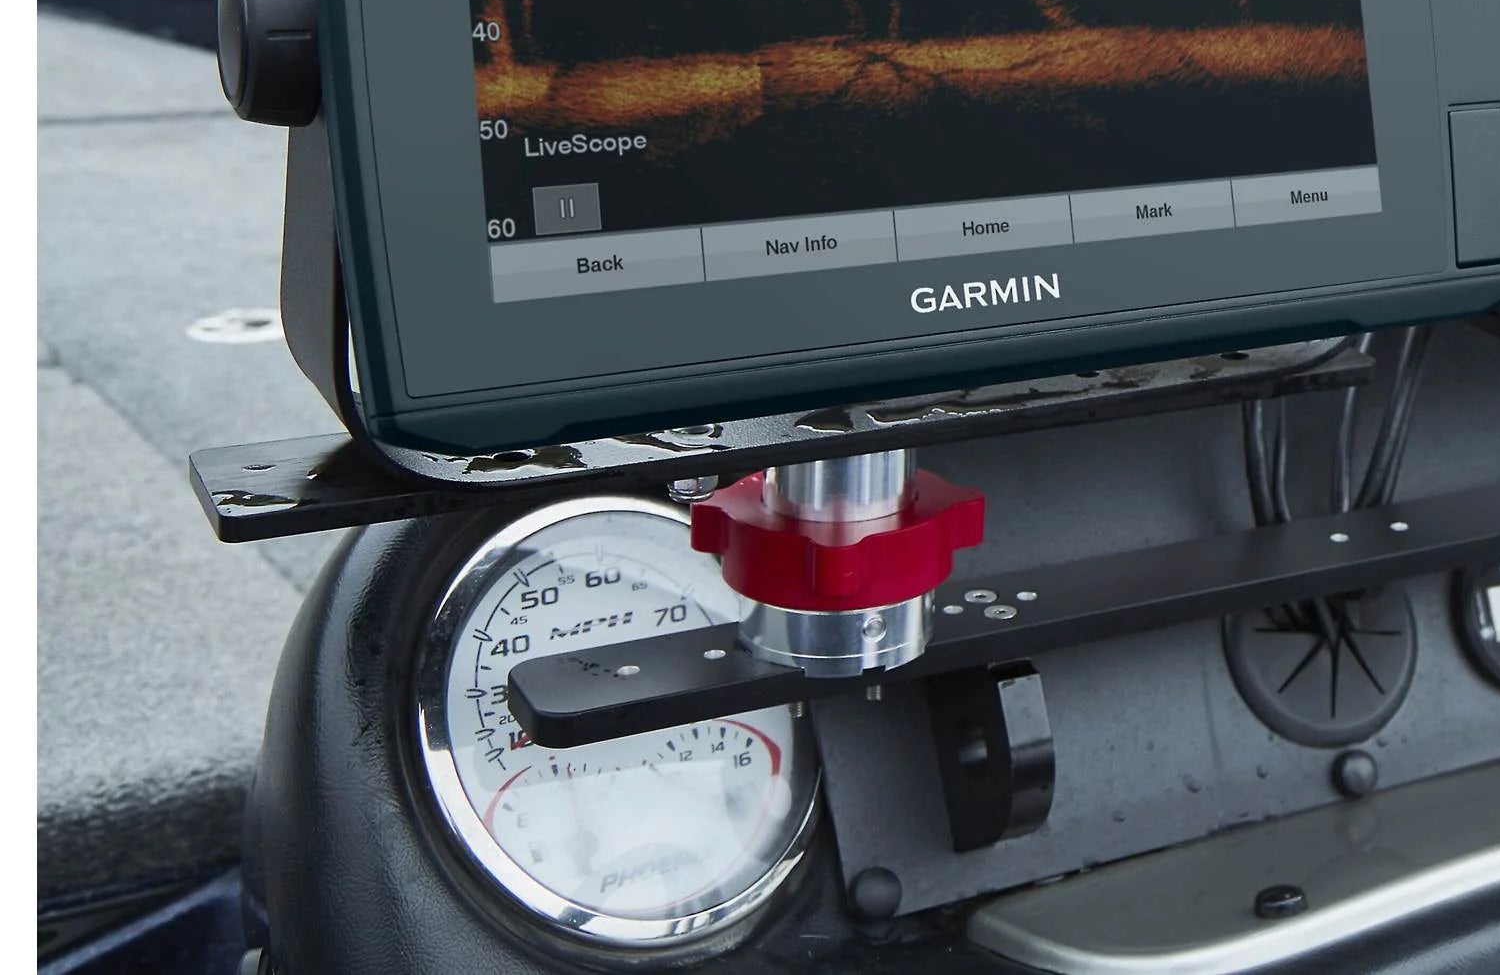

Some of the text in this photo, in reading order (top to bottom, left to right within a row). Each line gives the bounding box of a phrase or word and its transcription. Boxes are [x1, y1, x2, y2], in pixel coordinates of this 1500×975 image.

[472, 22, 500, 41] 40
[480, 120, 508, 139] 50
[524, 133, 648, 159] LiveScope
[1290, 187, 1329, 205] Menu
[1136, 202, 1173, 220] Mark
[488, 219, 516, 239] 60
[962, 218, 1010, 237] Home
[766, 234, 838, 256] Nav Info
[576, 254, 624, 275] Back
[910, 272, 1061, 314] GARMIN
[558, 575, 576, 586] 55
[585, 568, 621, 589] 60
[520, 587, 559, 611] 50
[510, 615, 528, 625] 45
[654, 604, 687, 627] 70
[550, 611, 633, 640] MPH
[490, 635, 530, 657] 40
[680, 750, 693, 762] 12
[711, 741, 725, 753] 14
[733, 751, 752, 769] 16
